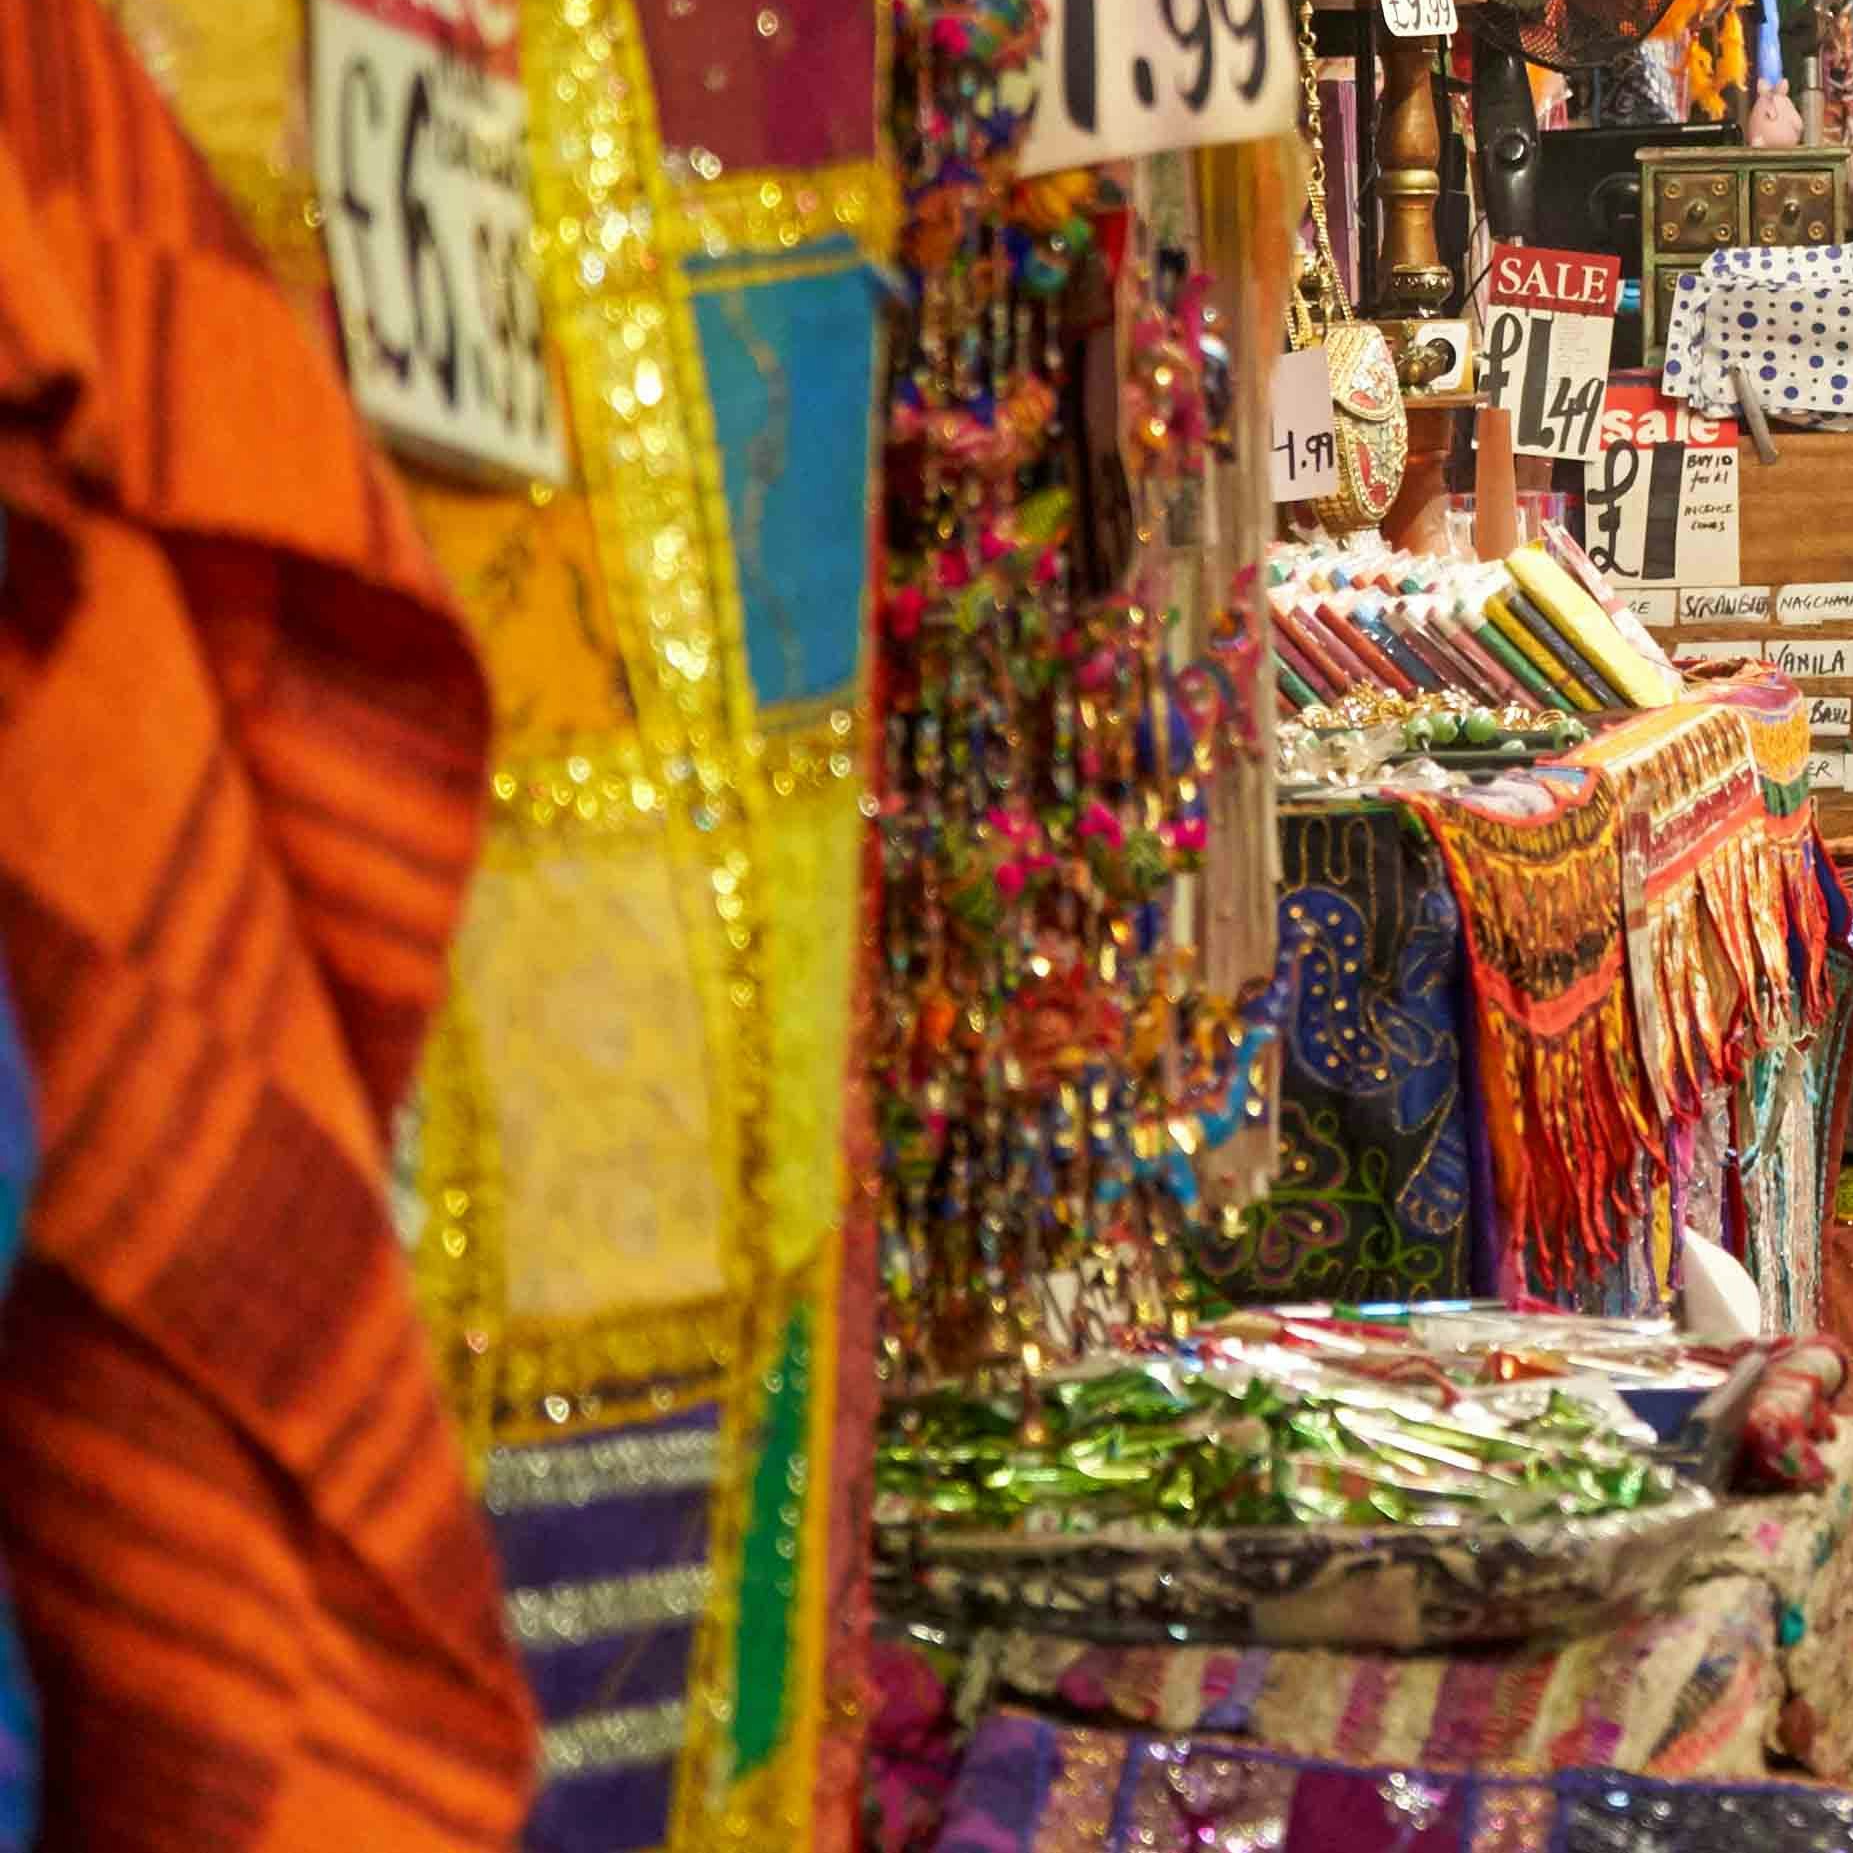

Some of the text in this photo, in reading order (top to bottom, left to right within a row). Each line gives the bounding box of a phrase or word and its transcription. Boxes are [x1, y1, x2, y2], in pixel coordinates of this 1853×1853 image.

[1497, 256, 1609, 305] SALE
[1601, 408, 1721, 445] sale
[1586, 439, 1686, 581] £1
[1769, 642, 1845, 675] VANILA
